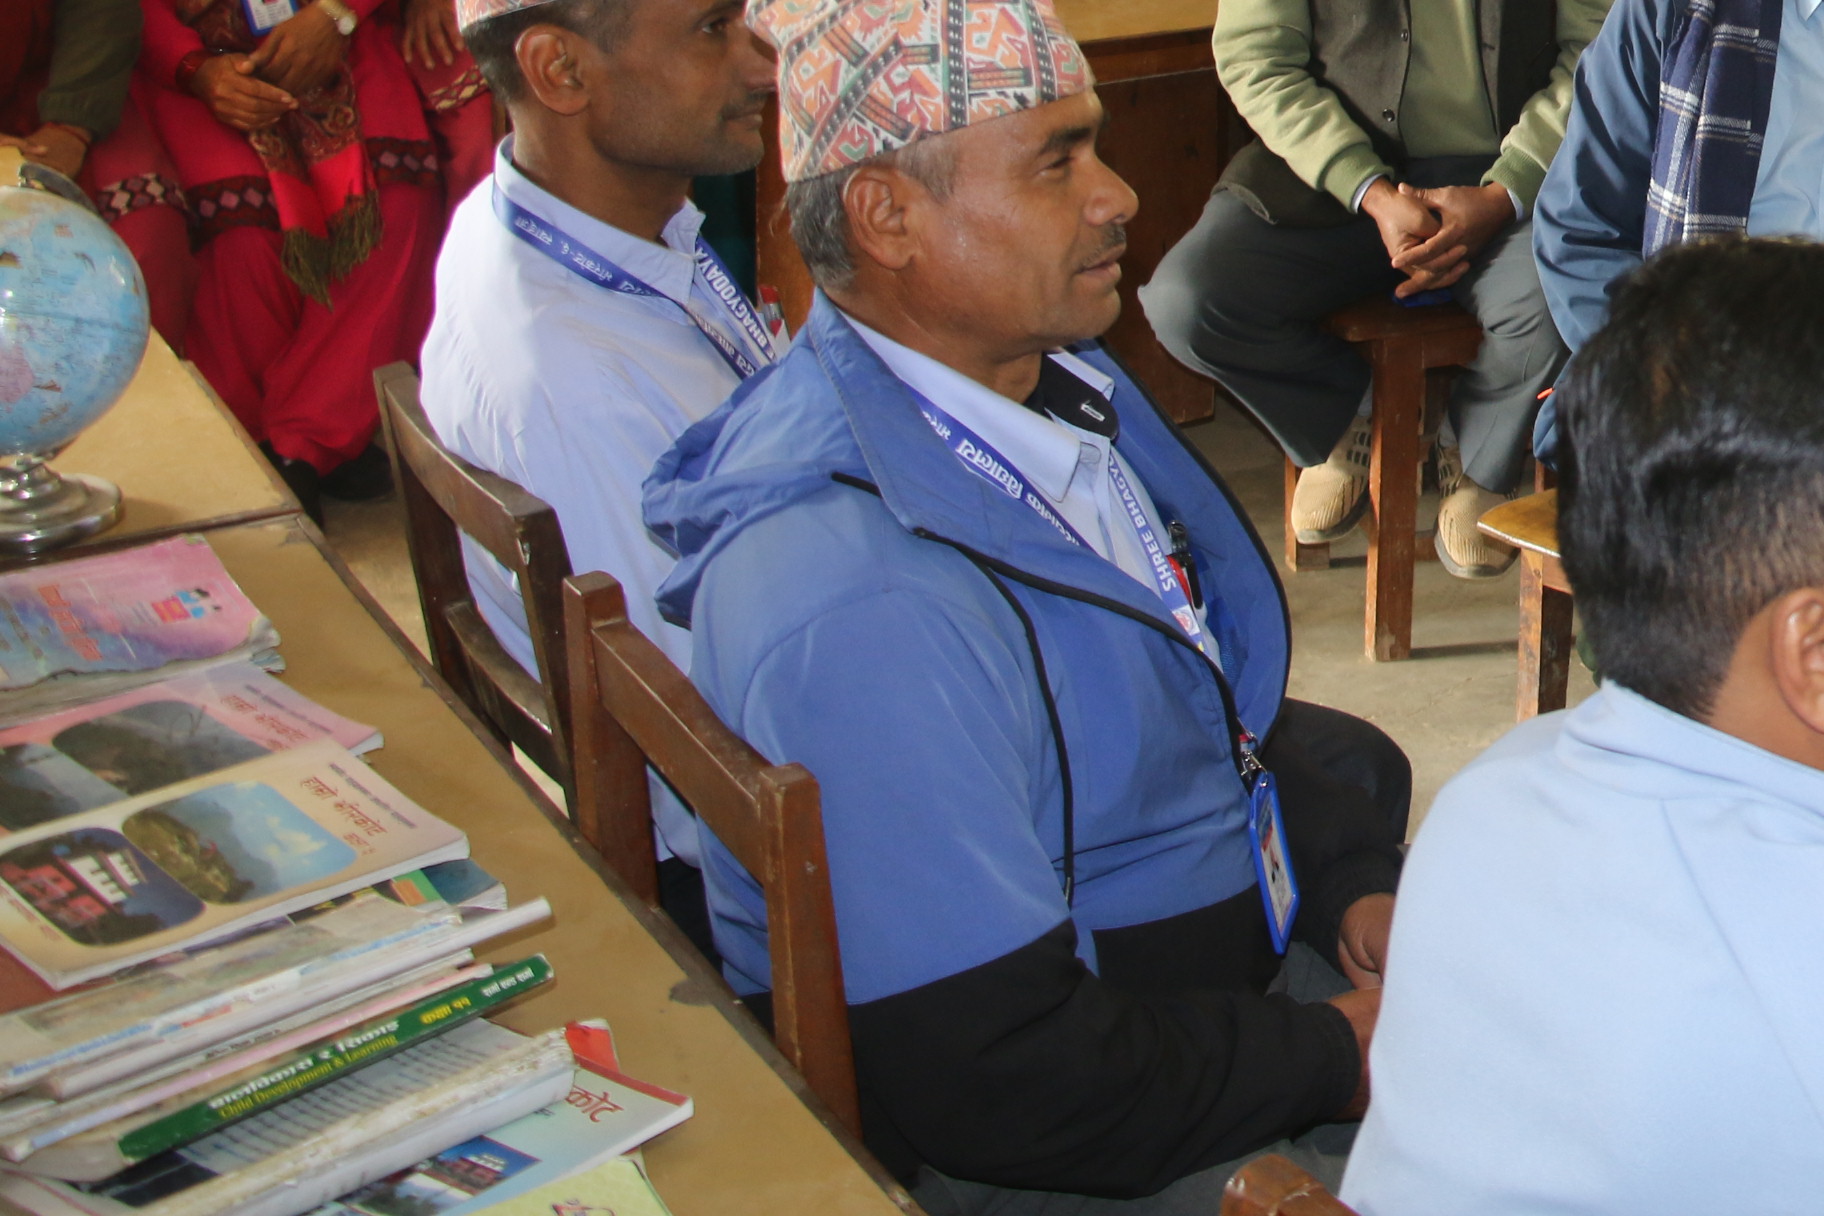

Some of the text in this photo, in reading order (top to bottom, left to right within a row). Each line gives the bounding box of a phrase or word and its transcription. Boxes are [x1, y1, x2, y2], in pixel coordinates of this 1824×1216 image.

[956, 436, 1025, 498] विद्यालय
[1142, 529, 1178, 593] SHREE
[220, 1034, 398, 1120] Child Development & Learning
[565, 1084, 624, 1123] कोट
